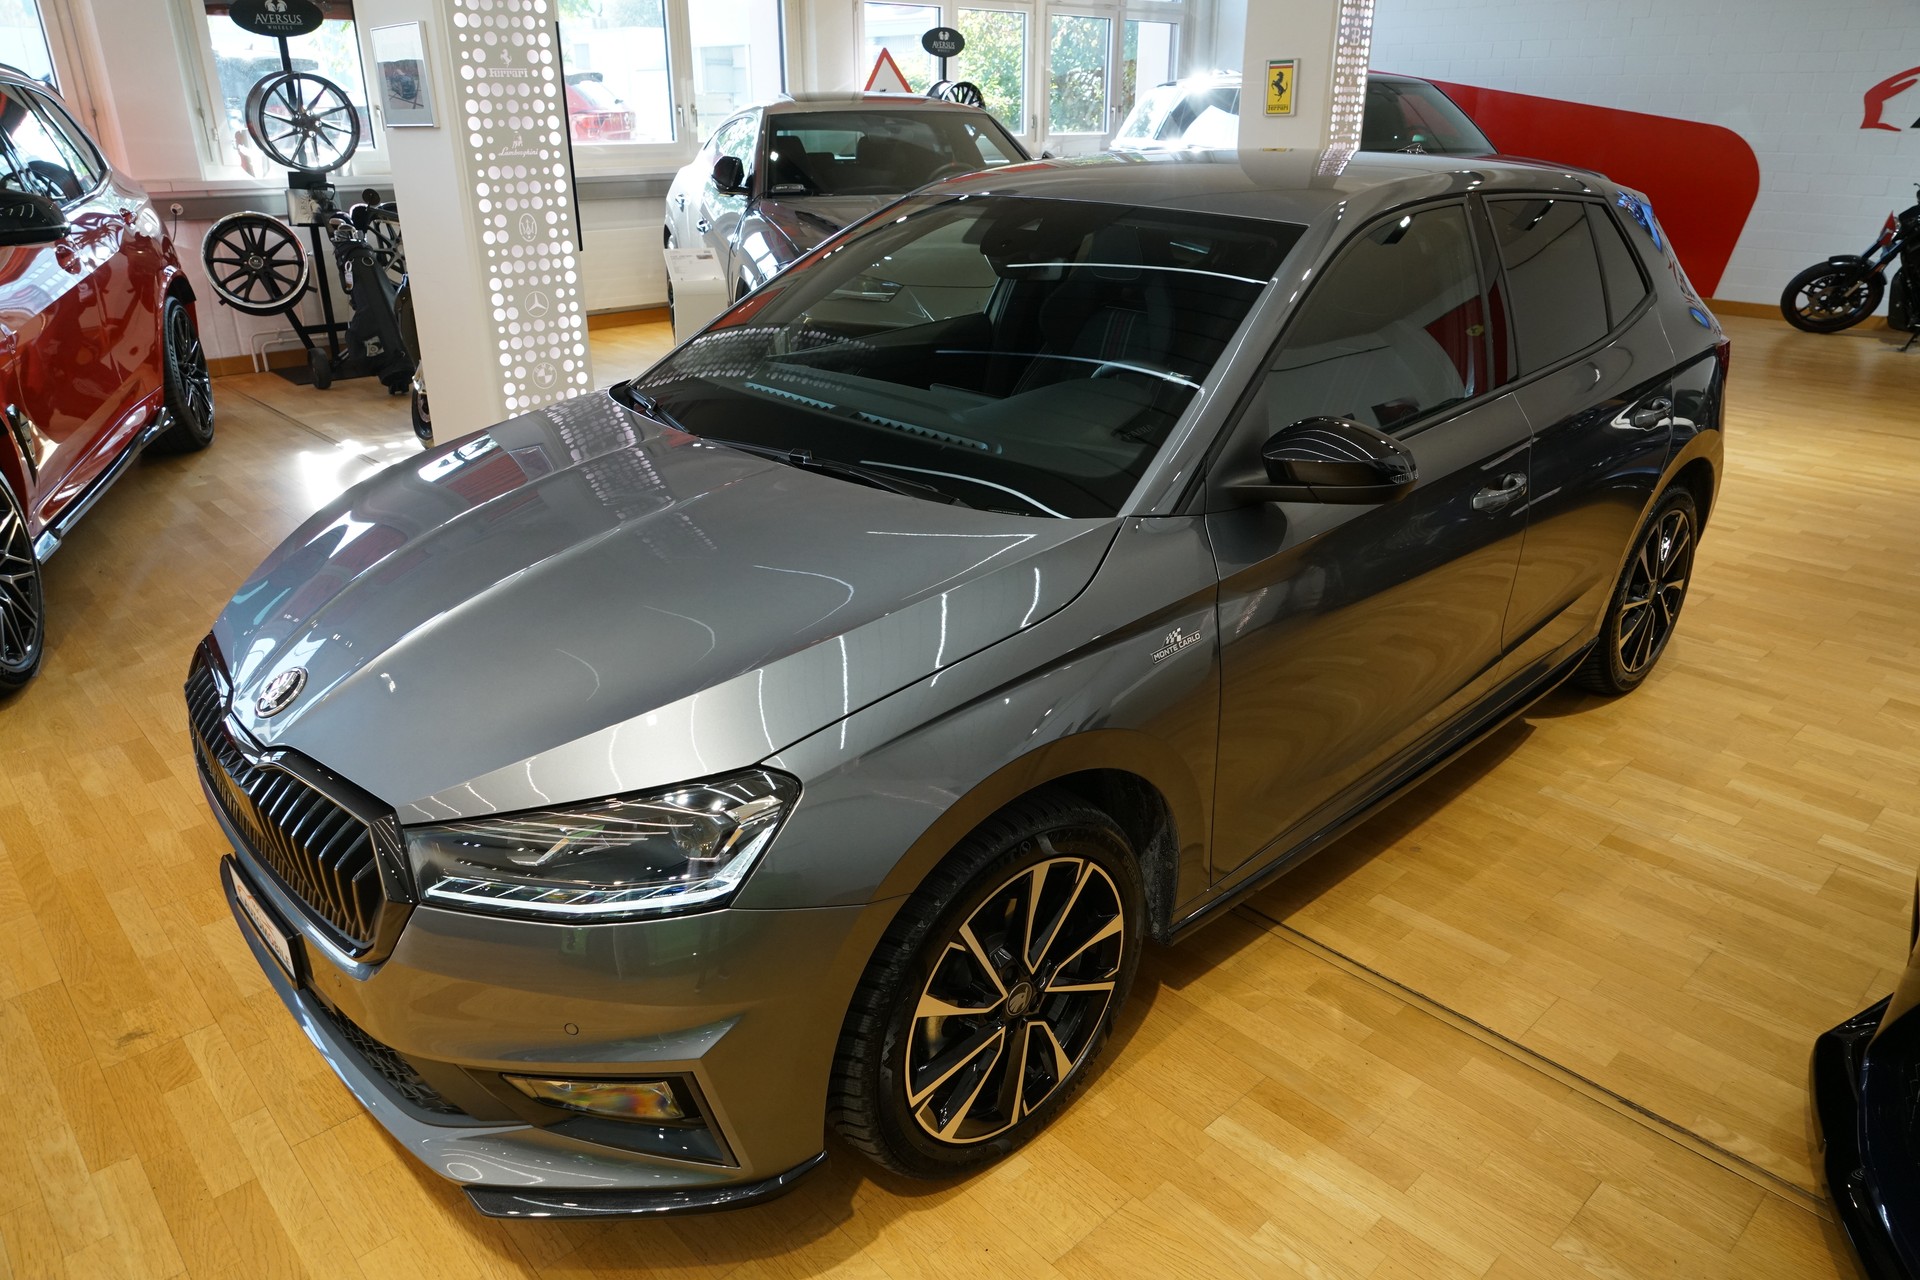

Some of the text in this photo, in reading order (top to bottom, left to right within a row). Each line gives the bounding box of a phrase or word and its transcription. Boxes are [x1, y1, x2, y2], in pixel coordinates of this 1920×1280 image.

[254, 13, 304, 25] AVERSUS
[931, 40, 956, 49] AVERSUS
[488, 67, 529, 78] Ferrari
[497, 146, 539, 158] Lamborghini
[1153, 632, 1201, 661] MONTE CARLO
